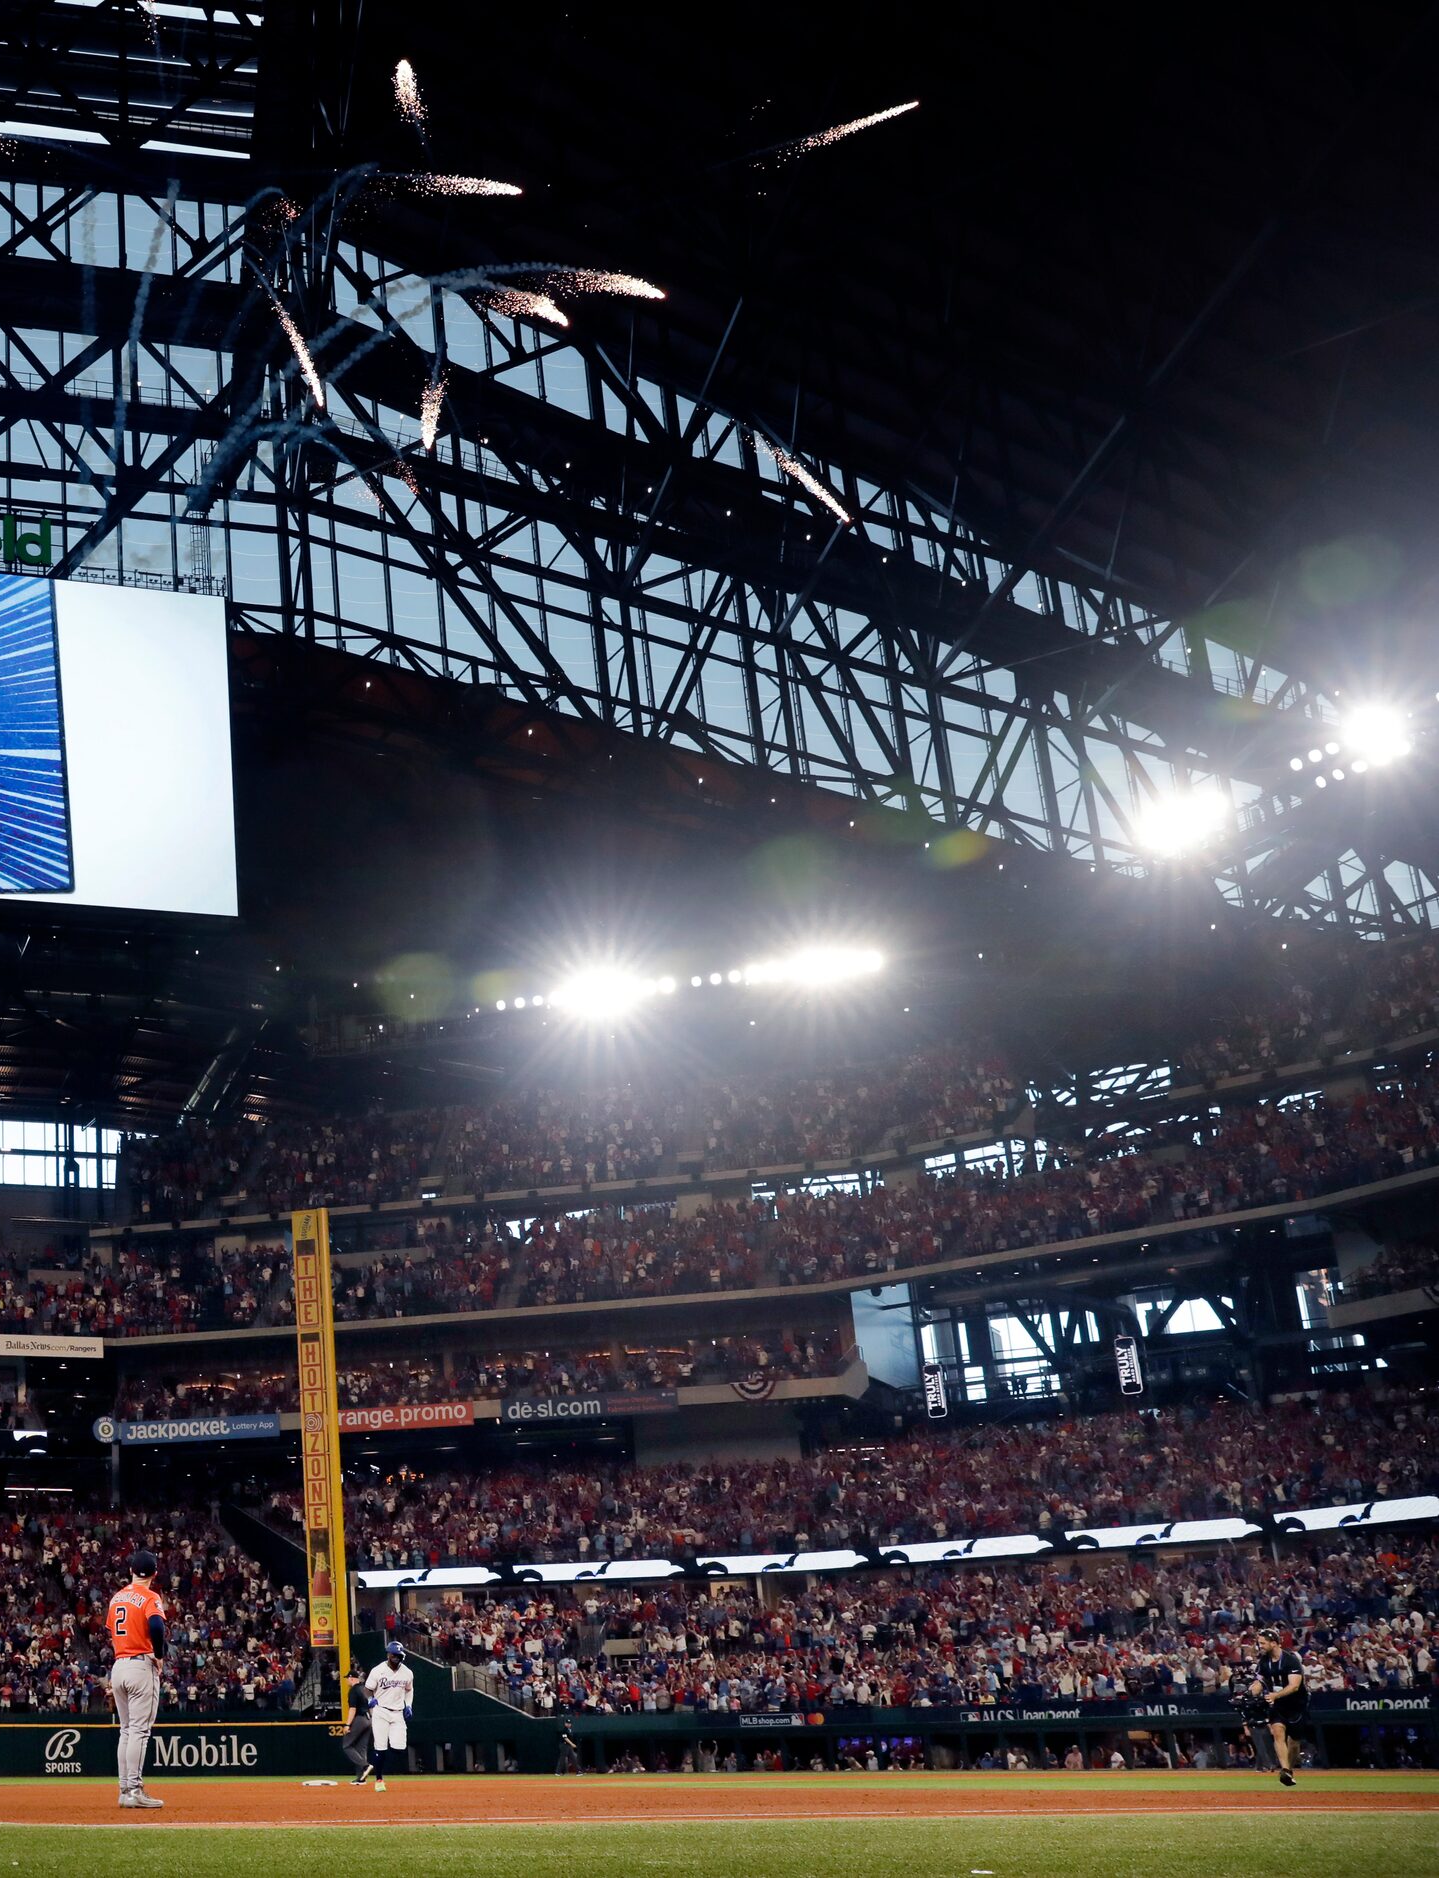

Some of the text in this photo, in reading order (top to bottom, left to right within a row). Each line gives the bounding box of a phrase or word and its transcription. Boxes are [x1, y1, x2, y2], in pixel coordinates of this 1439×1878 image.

[303, 1256, 313, 1323] THE
[304, 1344, 318, 1412] HOT
[1116, 1346, 1132, 1387] TRULY
[924, 1372, 938, 1410] TRULY
[232, 1421, 258, 1431] Lottery
[259, 1420, 275, 1430] App
[339, 1405, 467, 1429] range.promo
[309, 1433, 324, 1528] ZONE
[115, 1605, 128, 1637] 2
[982, 1709, 1013, 1721] ALCS
[1146, 1704, 1180, 1717] MLB
[1346, 1696, 1431, 1711] loanDepot
[741, 1717, 791, 1727] MLBshop.com
[153, 1734, 258, 1767] Mobile
[45, 1762, 82, 1773] SPORTS
